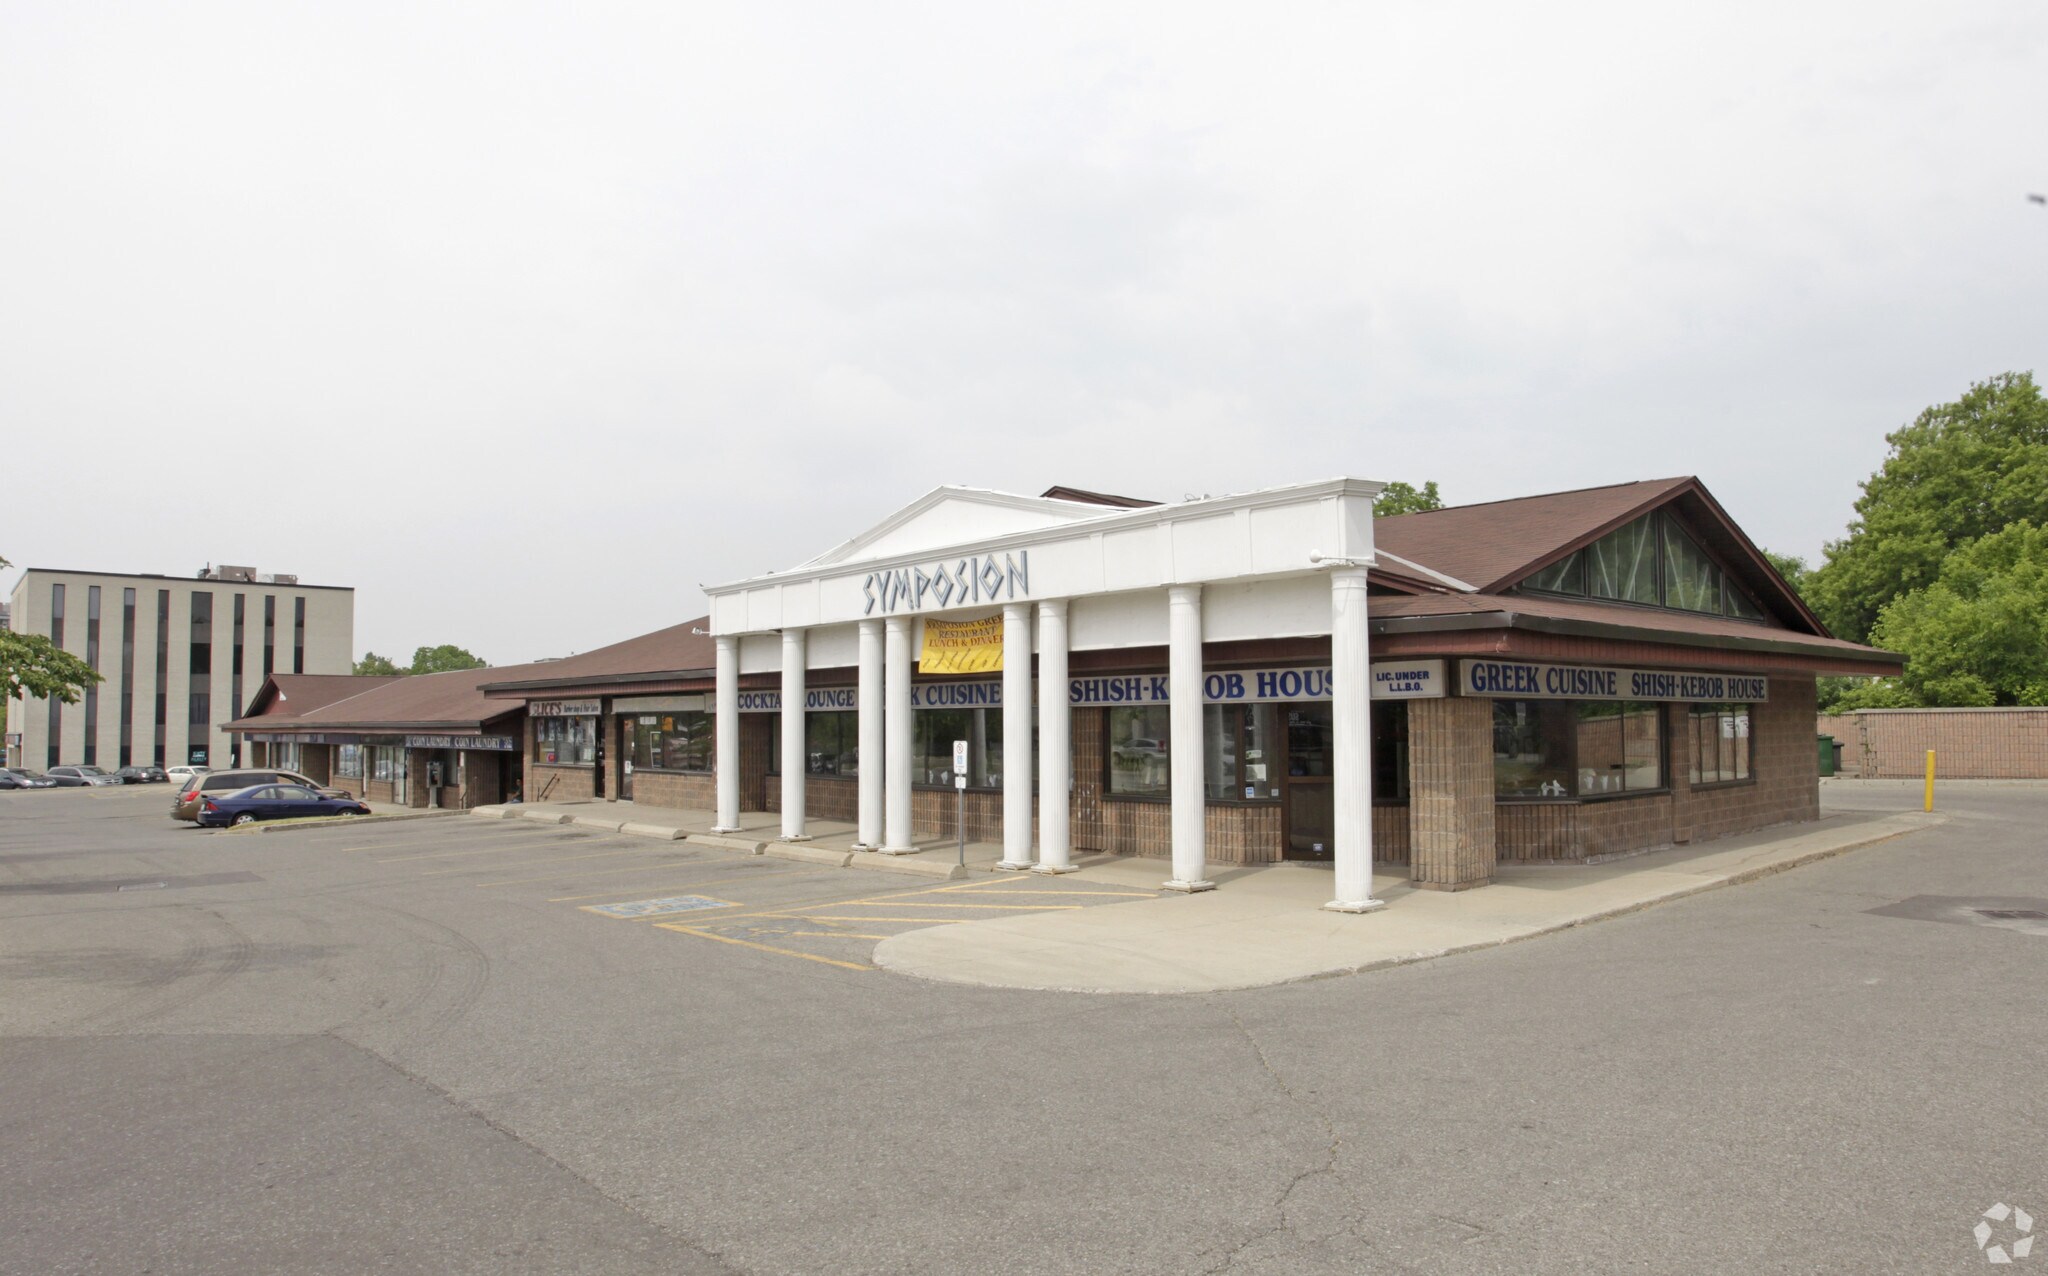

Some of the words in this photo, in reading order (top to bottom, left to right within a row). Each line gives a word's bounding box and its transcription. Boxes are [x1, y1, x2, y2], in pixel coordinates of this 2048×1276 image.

[863, 550, 1028, 615] SYMPOSION
[976, 614, 1004, 626] GREE
[939, 625, 997, 639] RESTAURANT
[928, 638, 959, 647] LUNCH
[961, 639, 968, 647] &
[1395, 671, 1429, 680] UNDER
[1471, 662, 1540, 693] GREEK
[1546, 667, 1617, 695] CUISINE
[1728, 678, 1765, 699] HOUSE
[1256, 670, 1333, 698] HOU
[1389, 682, 1423, 692] L.L.B.O.
[737, 692, 782, 709] COCKTA
[805, 690, 855, 708] OUNGE
[926, 683, 1001, 705] CUISINE
